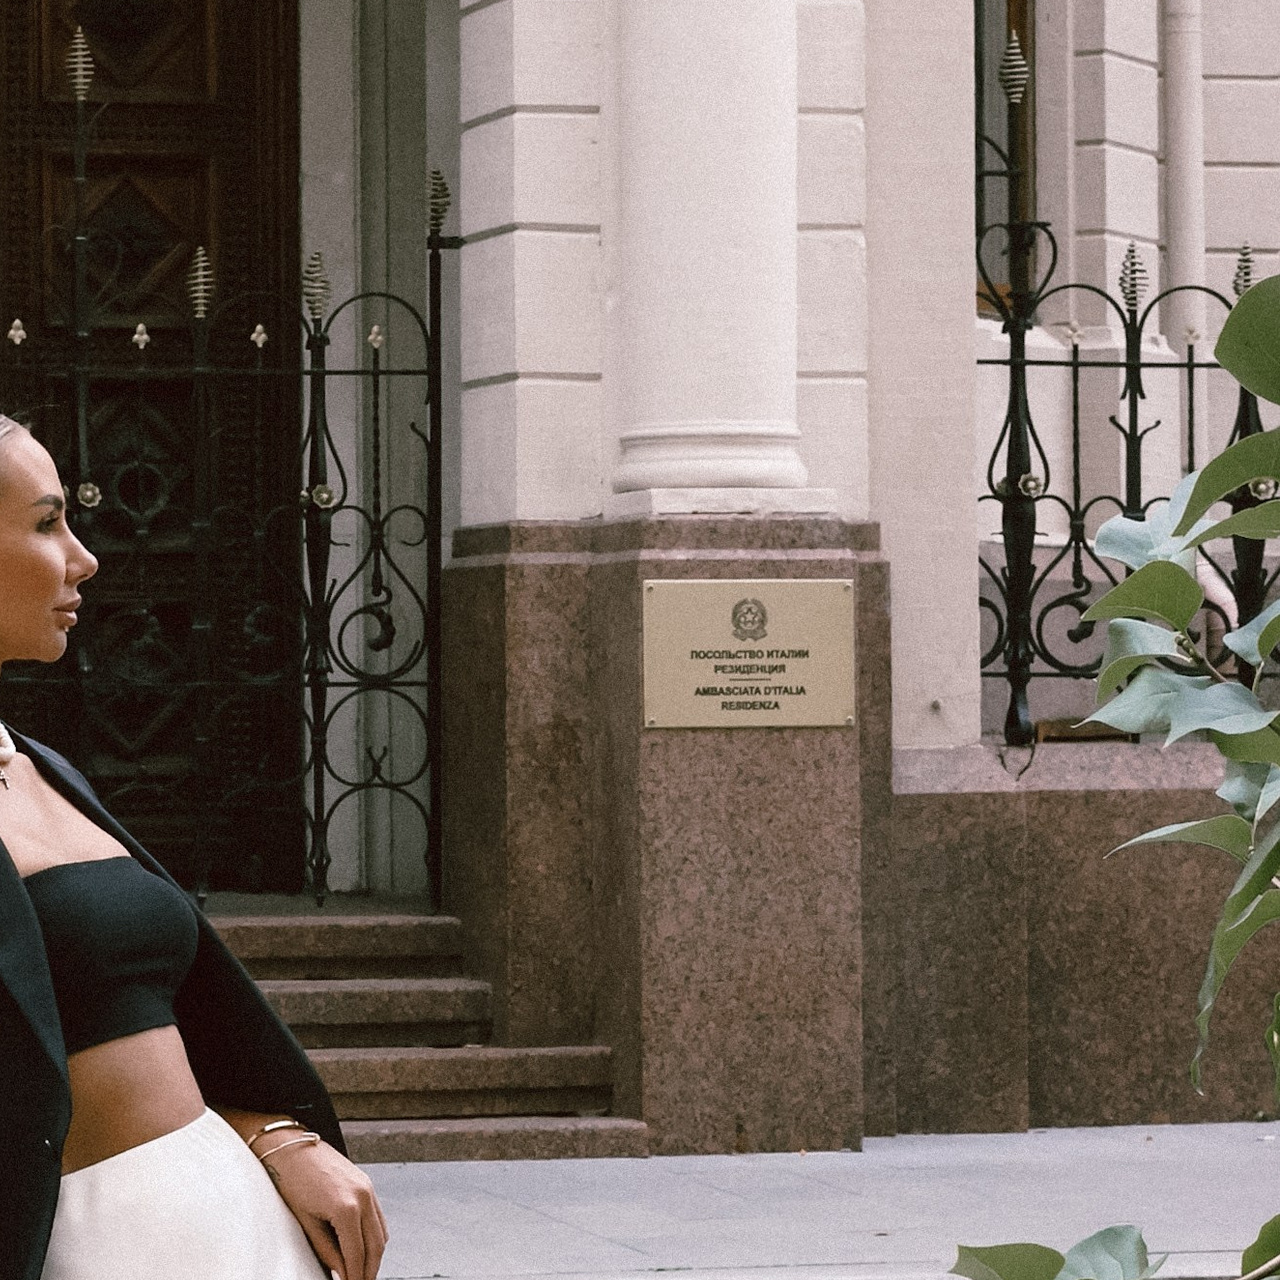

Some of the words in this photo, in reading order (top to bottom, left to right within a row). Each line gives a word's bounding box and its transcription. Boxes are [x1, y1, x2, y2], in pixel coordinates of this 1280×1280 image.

[690, 649, 764, 660] ПОСОЛЬСТВО
[766, 649, 810, 659] ИТАЛИИ
[714, 664, 786, 674] РЕЗИДЕНЦИЯ
[694, 686, 762, 696] AMBASCIATA
[764, 685, 806, 695] D'ITALIA
[721, 701, 780, 711] RESIDENZA
